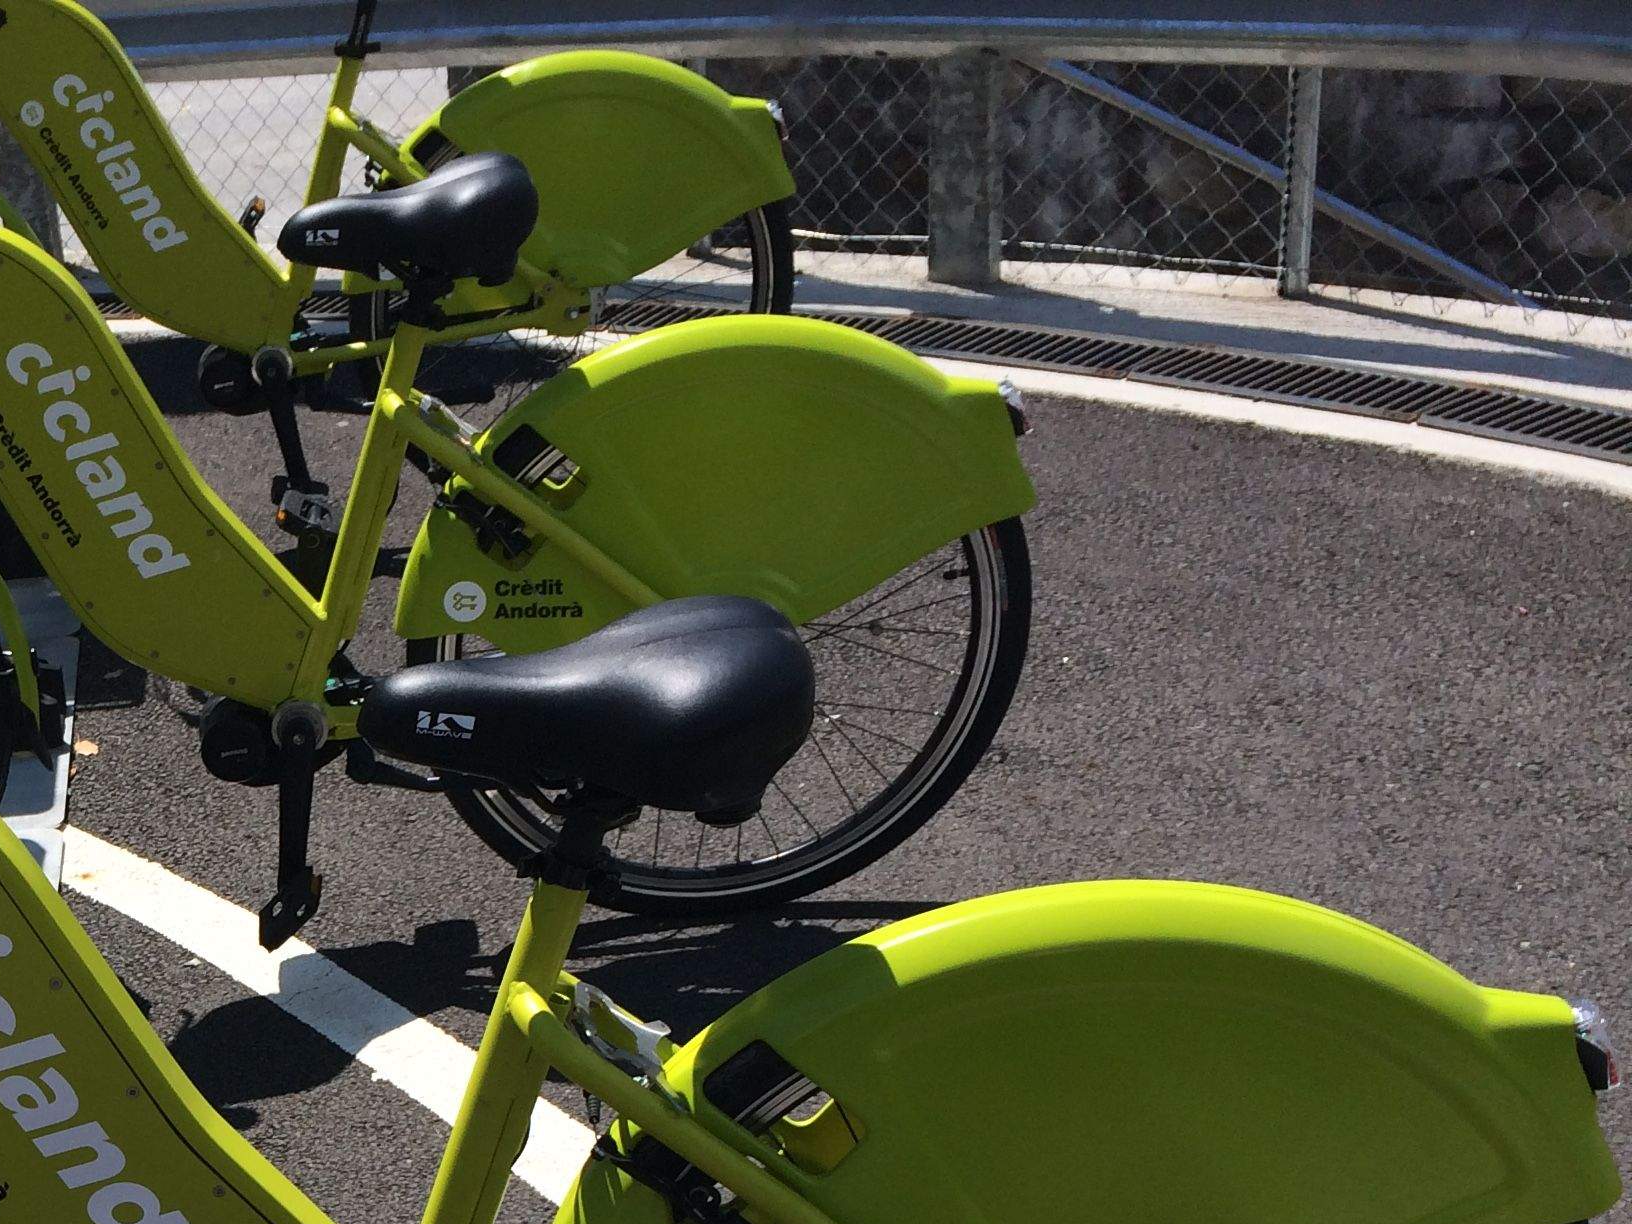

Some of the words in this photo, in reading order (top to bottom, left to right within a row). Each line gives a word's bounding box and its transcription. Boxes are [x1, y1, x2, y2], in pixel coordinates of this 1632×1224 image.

[40, 126, 72, 173] Crèdit
[68, 173, 109, 230] Andorrà
[26, 473, 82, 548] Andorrà
[494, 578, 564, 597] Crèdit
[494, 602, 583, 621] Andorrà
